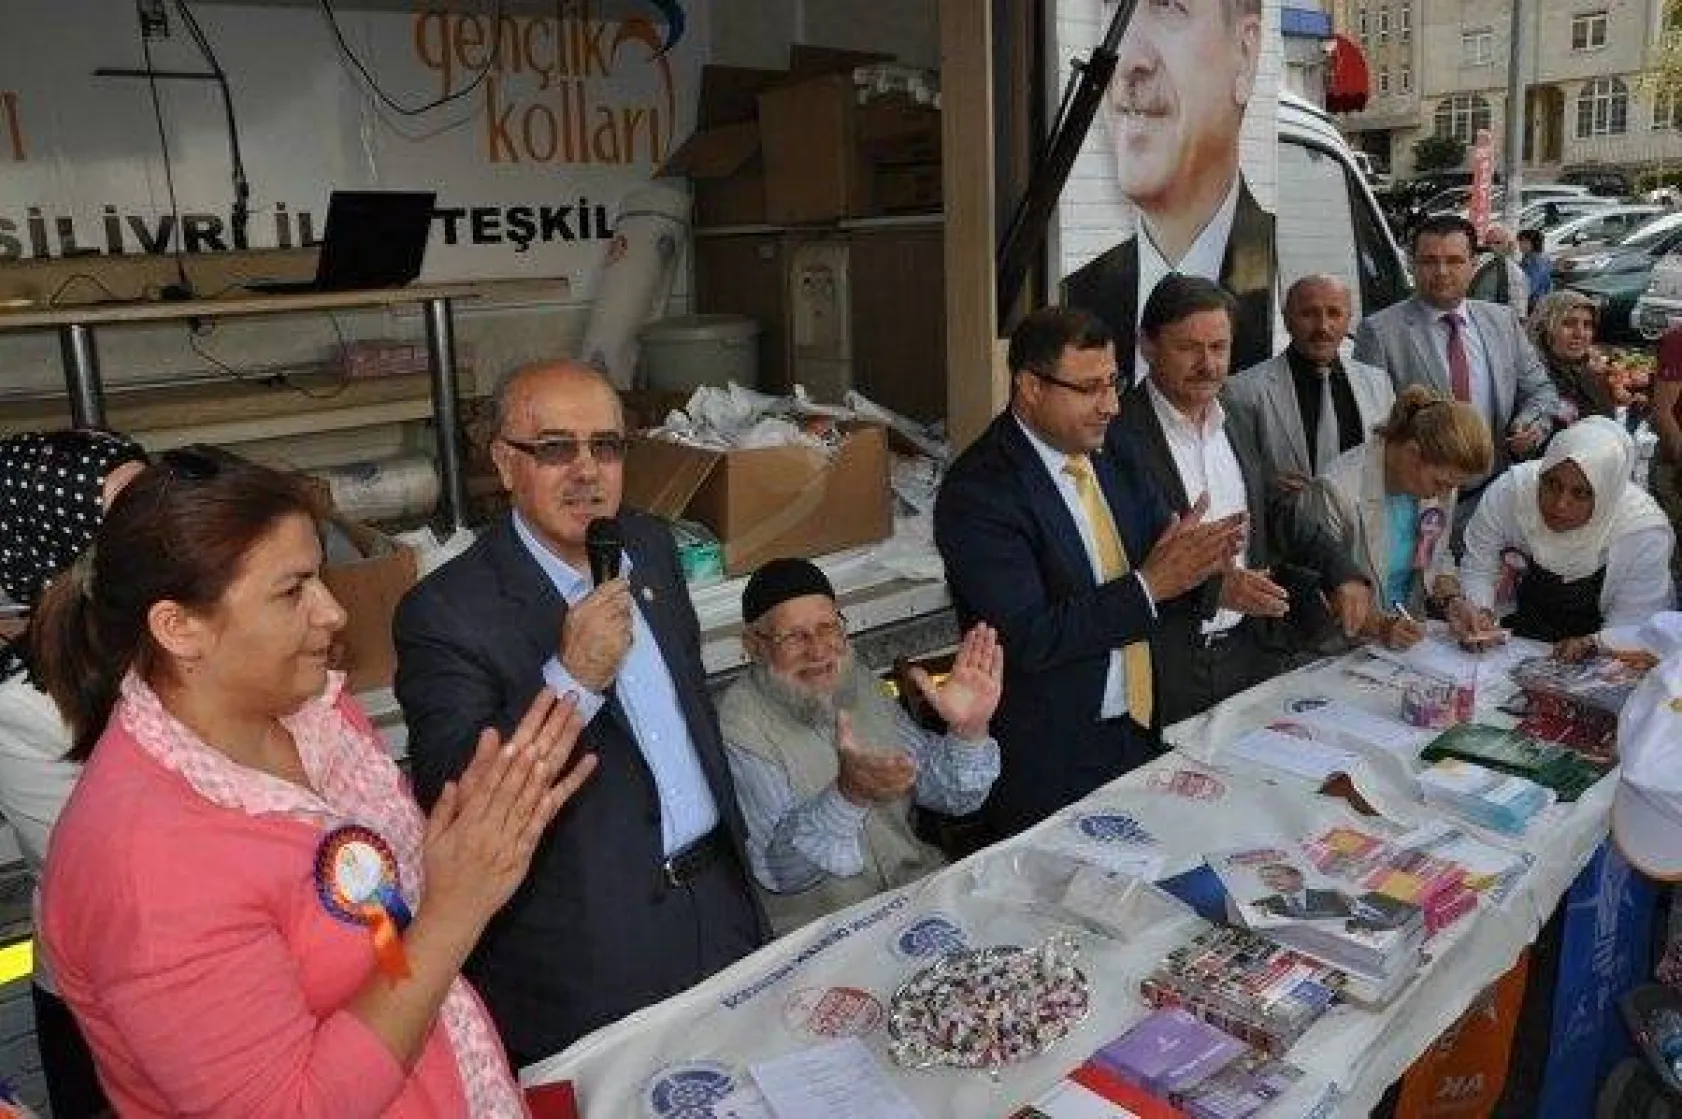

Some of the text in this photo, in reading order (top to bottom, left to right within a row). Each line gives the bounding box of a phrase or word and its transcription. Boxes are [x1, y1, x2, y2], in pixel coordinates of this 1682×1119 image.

[415, 0, 609, 99] gençlik
[486, 76, 660, 164] kolları
[273, 202, 325, 250] İL
[431, 196, 615, 253] TEŞKİL
